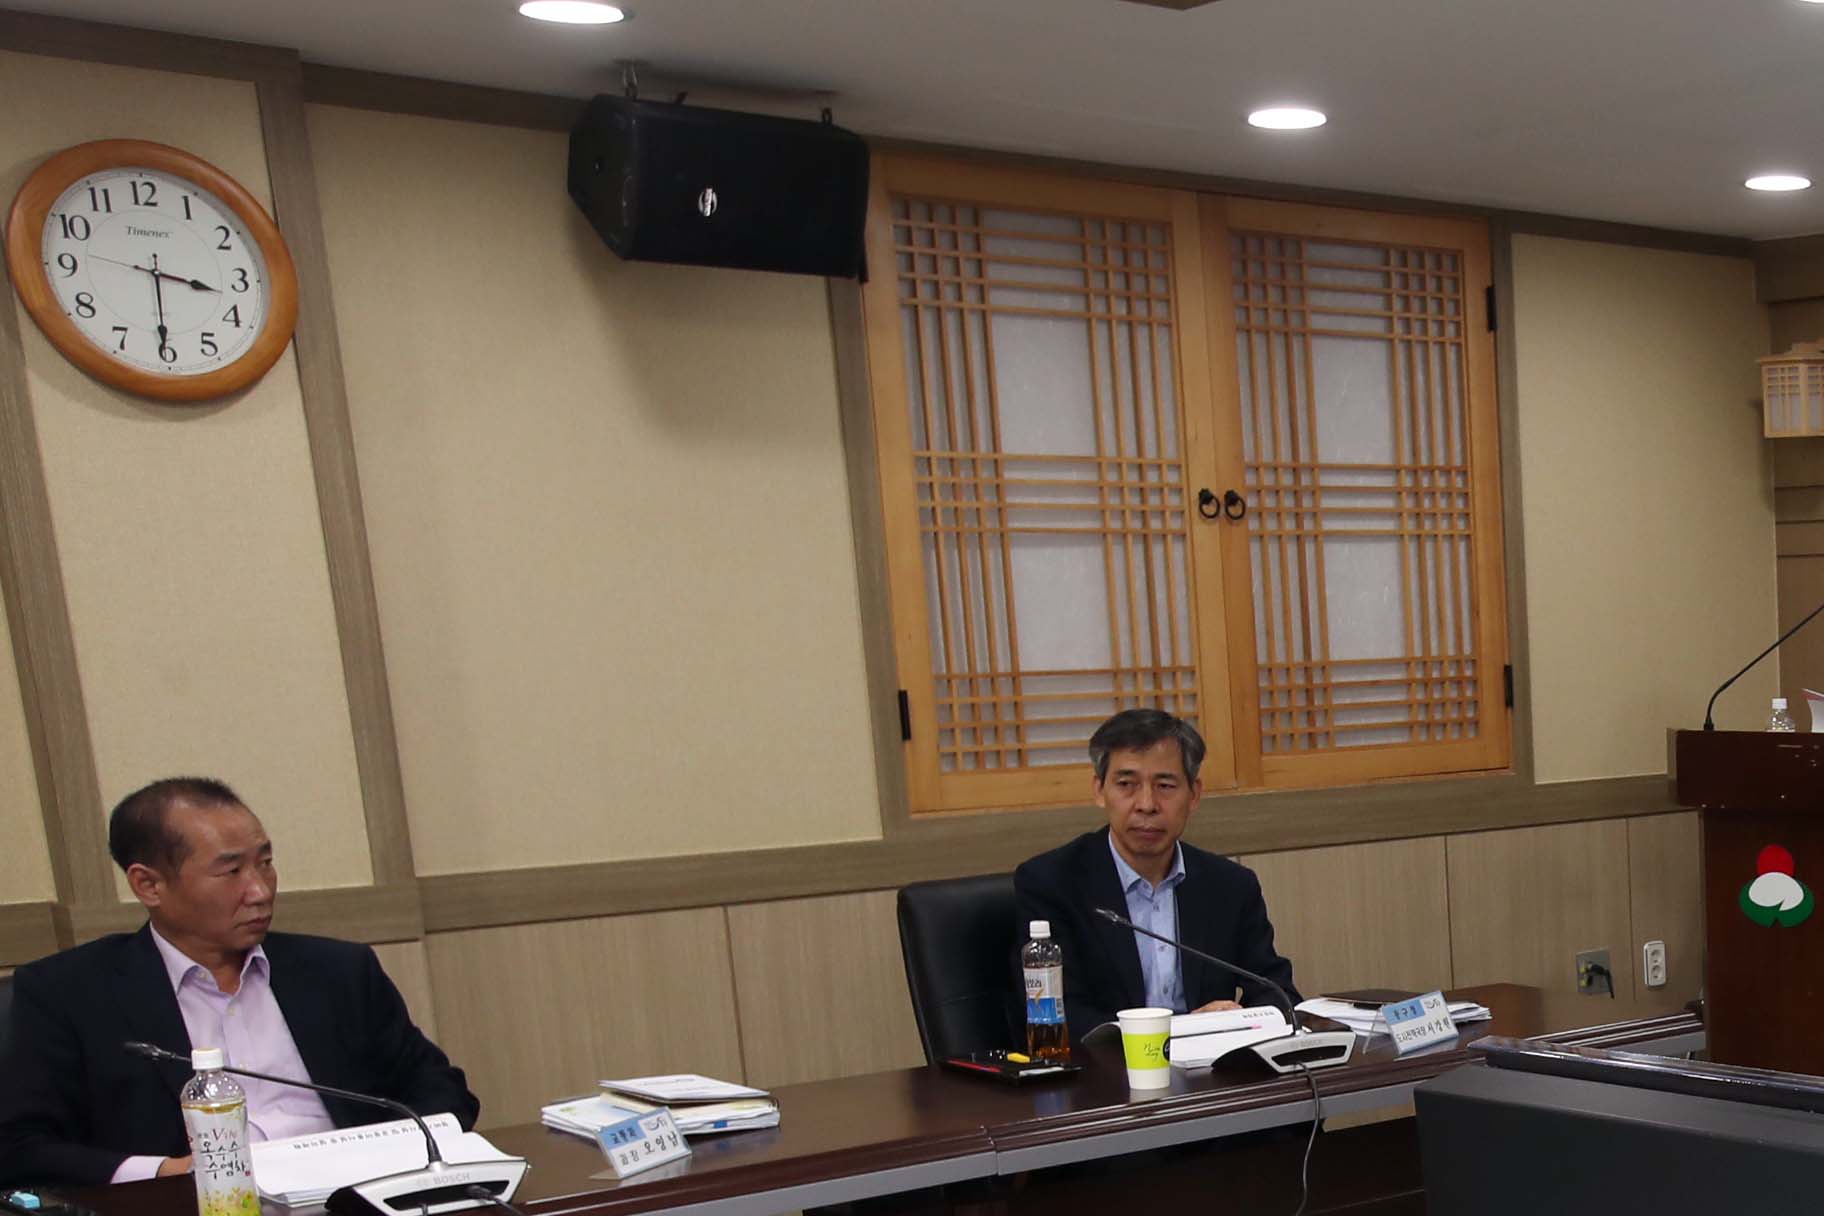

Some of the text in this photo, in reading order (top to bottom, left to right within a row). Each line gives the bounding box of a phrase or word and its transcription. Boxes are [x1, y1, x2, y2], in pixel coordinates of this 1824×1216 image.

[88, 186, 113, 213] 11
[129, 180, 159, 208] 12
[181, 195, 193, 220] 1
[59, 213, 91, 241] 10
[214, 225, 232, 251] 2
[57, 252, 78, 279] 9
[230, 267, 250, 293] 3
[74, 291, 96, 319] 8
[221, 303, 242, 329] 4
[111, 325, 129, 351] 7
[158, 338, 178, 364] 6
[199, 331, 219, 357] 5
[200, 1140, 241, 1161] 옥수수
[205, 1160, 246, 1180] 수염차
